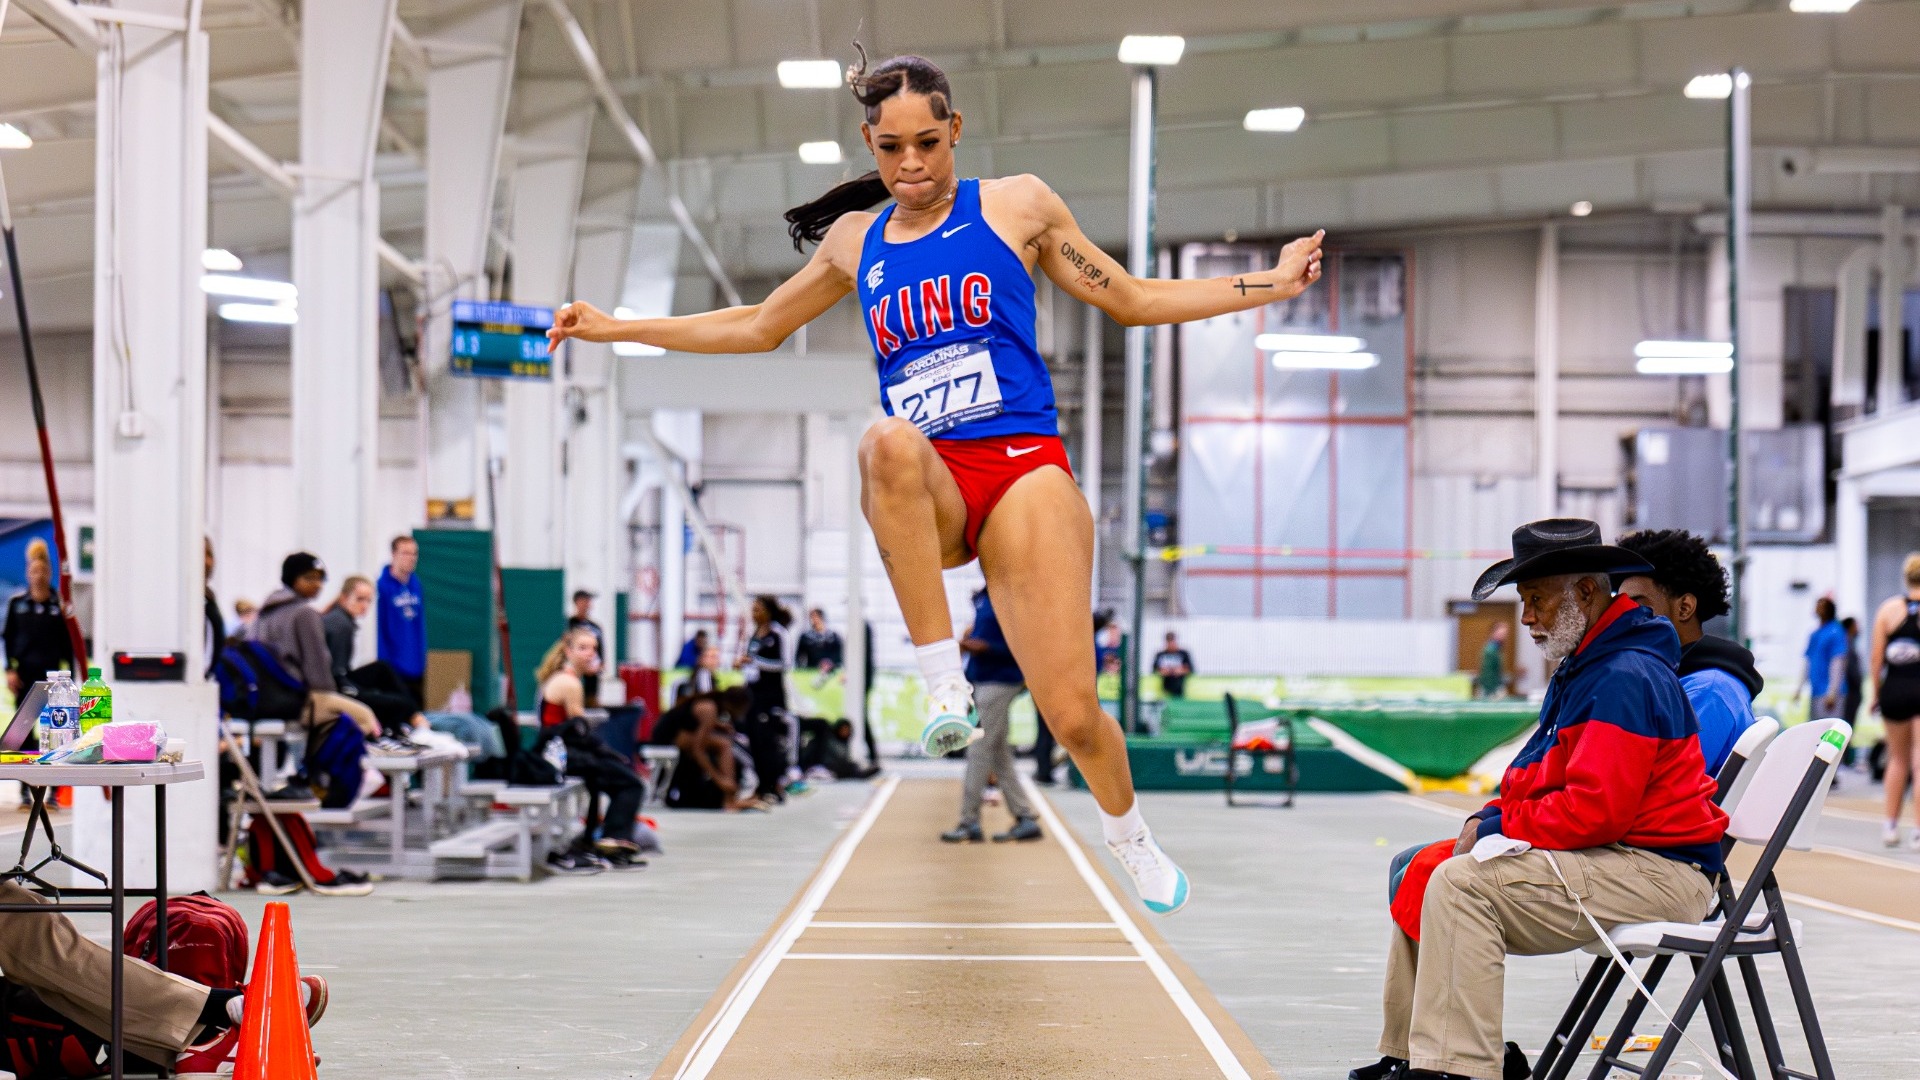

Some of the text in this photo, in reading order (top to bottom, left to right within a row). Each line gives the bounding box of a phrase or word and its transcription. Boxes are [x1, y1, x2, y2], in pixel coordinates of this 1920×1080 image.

[1061, 242, 1110, 289] ONE OF A
[869, 272, 992, 359] KING
[904, 344, 969, 378] CAROLINAS
[901, 370, 982, 426] 277
